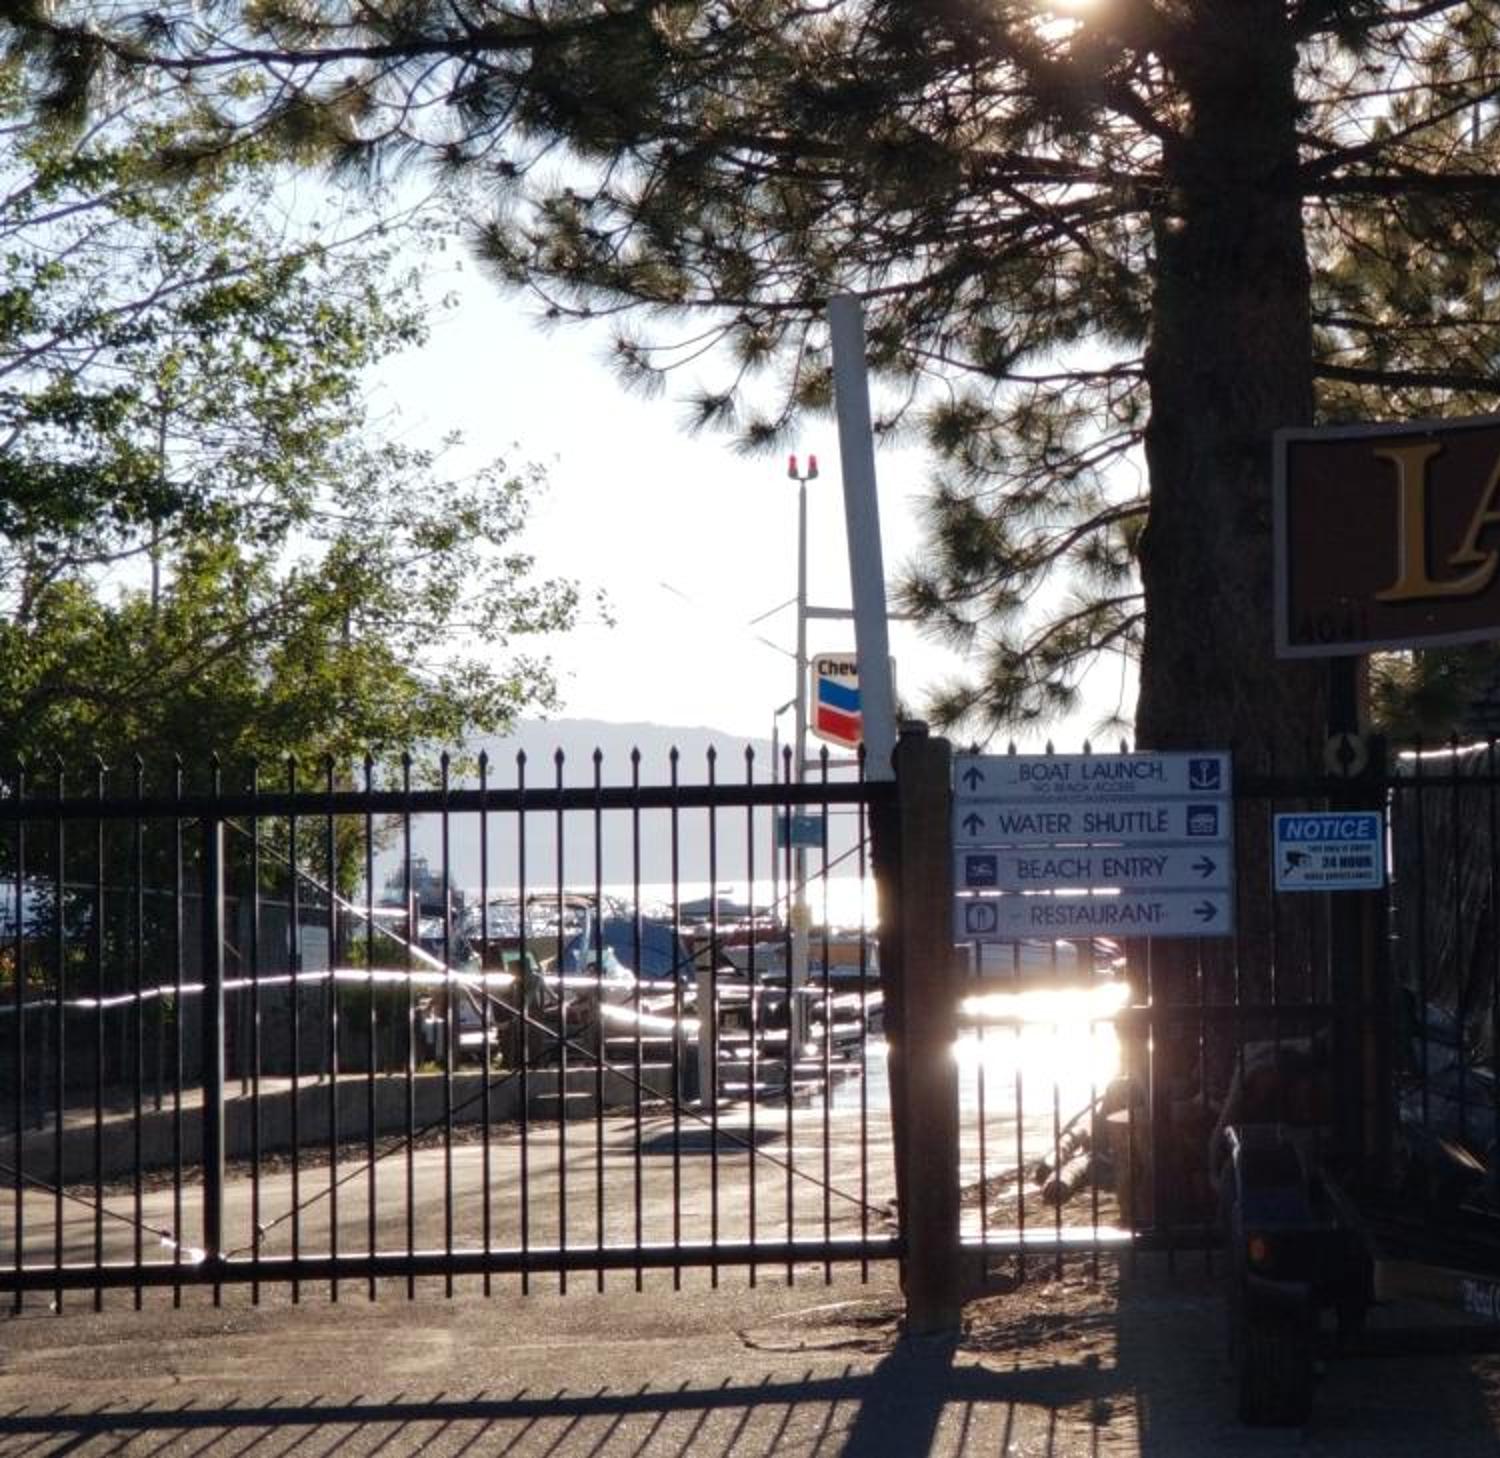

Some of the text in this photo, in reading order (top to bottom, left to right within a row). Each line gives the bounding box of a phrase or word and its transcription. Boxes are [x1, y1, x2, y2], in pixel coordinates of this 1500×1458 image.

[818, 660, 857, 675] Chev
[1019, 760, 1164, 782] BOAT LAUNCH
[999, 809, 1168, 834] WATER SHUTTLE
[1285, 818, 1371, 839] NOTICE
[1017, 854, 1168, 879] BEACH ENTRY
[1322, 855, 1371, 868] 24 HOUR
[1031, 902, 1162, 926] RESTAURANT
